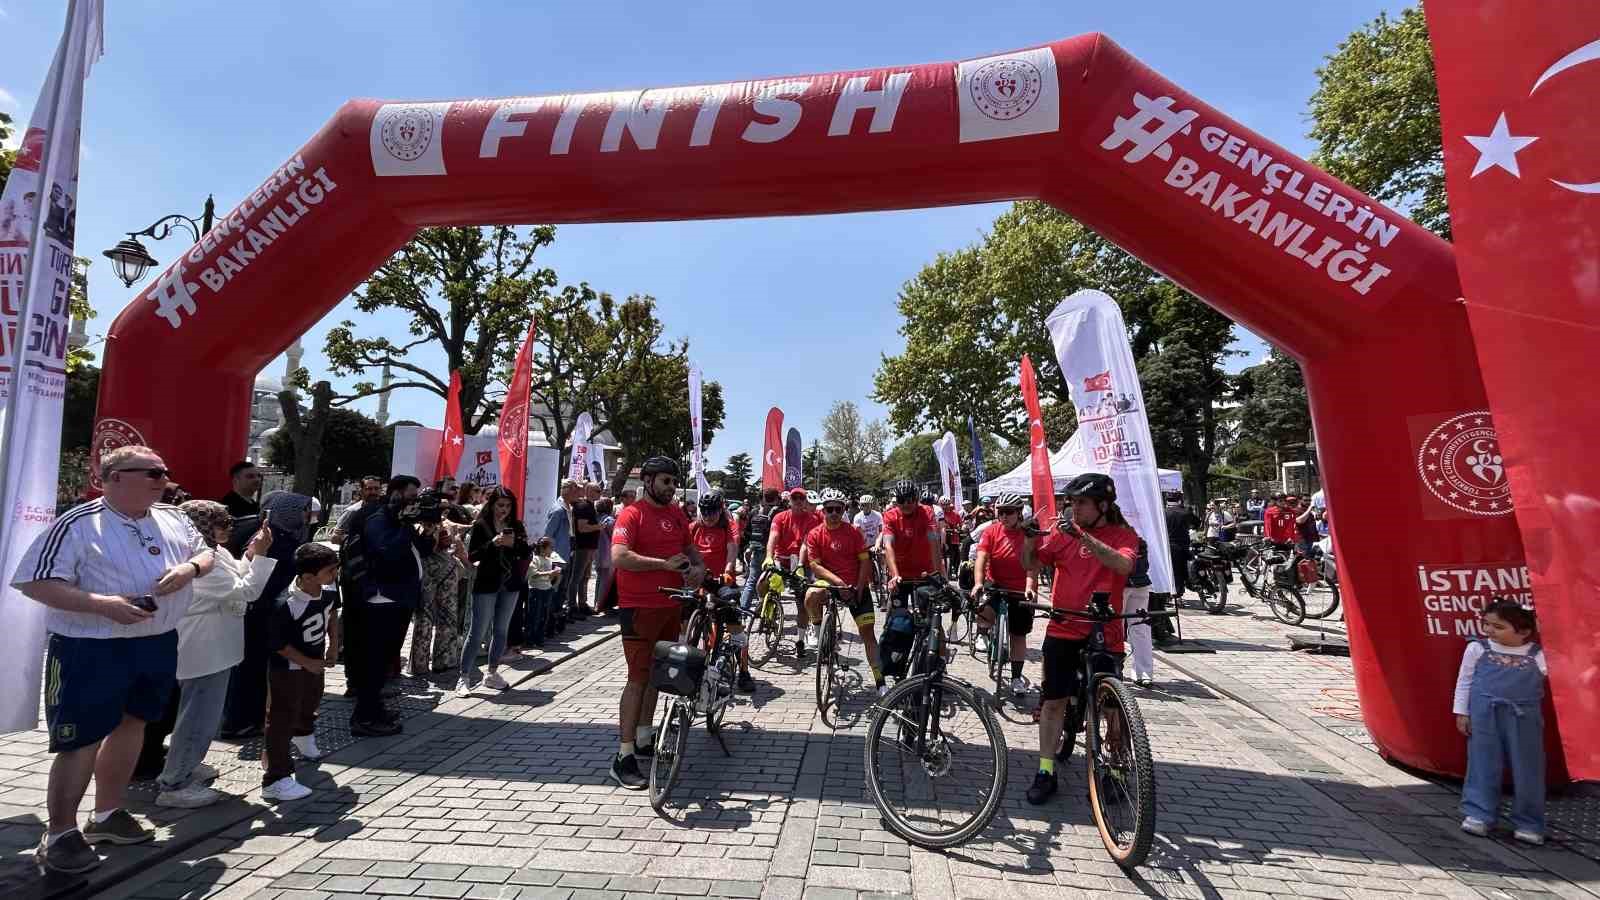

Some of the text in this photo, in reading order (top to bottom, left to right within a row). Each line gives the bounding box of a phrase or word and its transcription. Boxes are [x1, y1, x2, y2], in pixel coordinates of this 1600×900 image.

[479, 72, 912, 159] FINISH
[187, 154, 305, 264] GENÇLERİN
[200, 166, 337, 293] BAKANLIĞI
[1164, 156, 1392, 295] BAKANLIĞI
[1199, 125, 1400, 248] GENÇLERİN
[1427, 614, 1448, 635] İL
